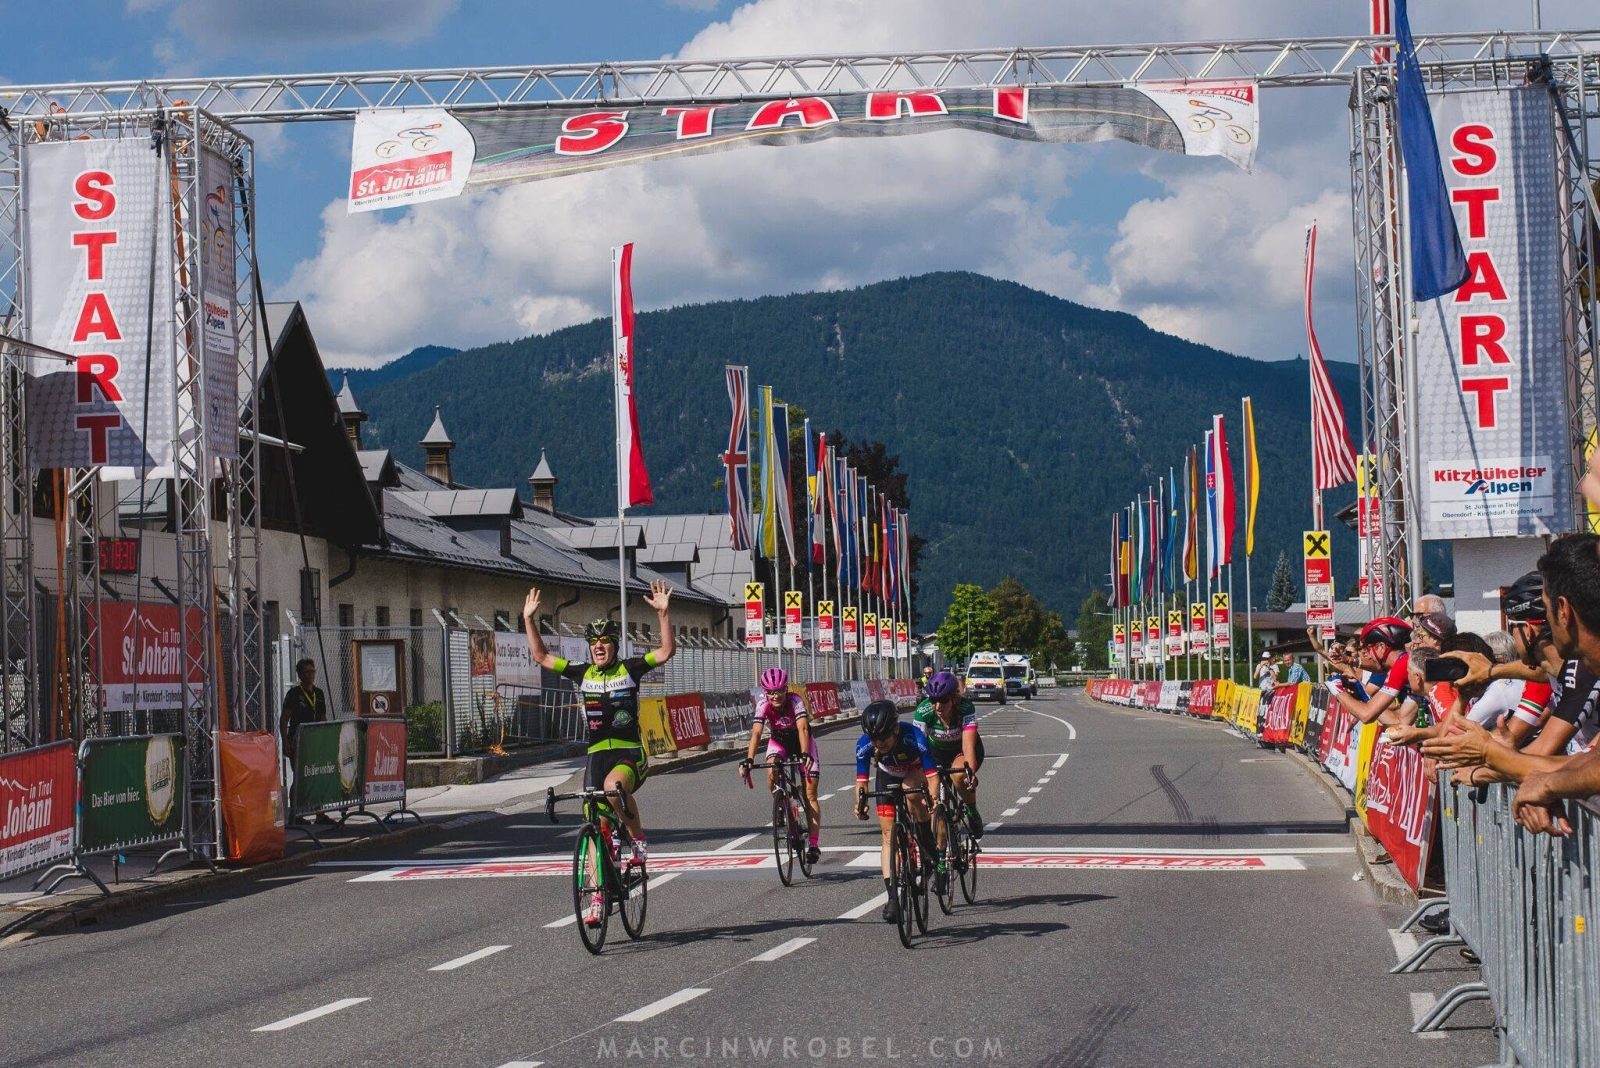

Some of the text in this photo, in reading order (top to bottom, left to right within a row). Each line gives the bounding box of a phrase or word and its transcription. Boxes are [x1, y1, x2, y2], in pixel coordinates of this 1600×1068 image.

[356, 168, 446, 197] St. Johann
[1452, 124, 1511, 428] START
[72, 170, 124, 464] START
[1434, 466, 1547, 485] Kitzbüheler
[1464, 479, 1532, 495] Alpen
[170, 628, 181, 643] Tiro
[38, 778, 53, 797] Tirol
[92, 793, 103, 808] Das
[103, 790, 115, 806] Bier
[116, 793, 126, 804] von
[2, 796, 52, 839] Johann
